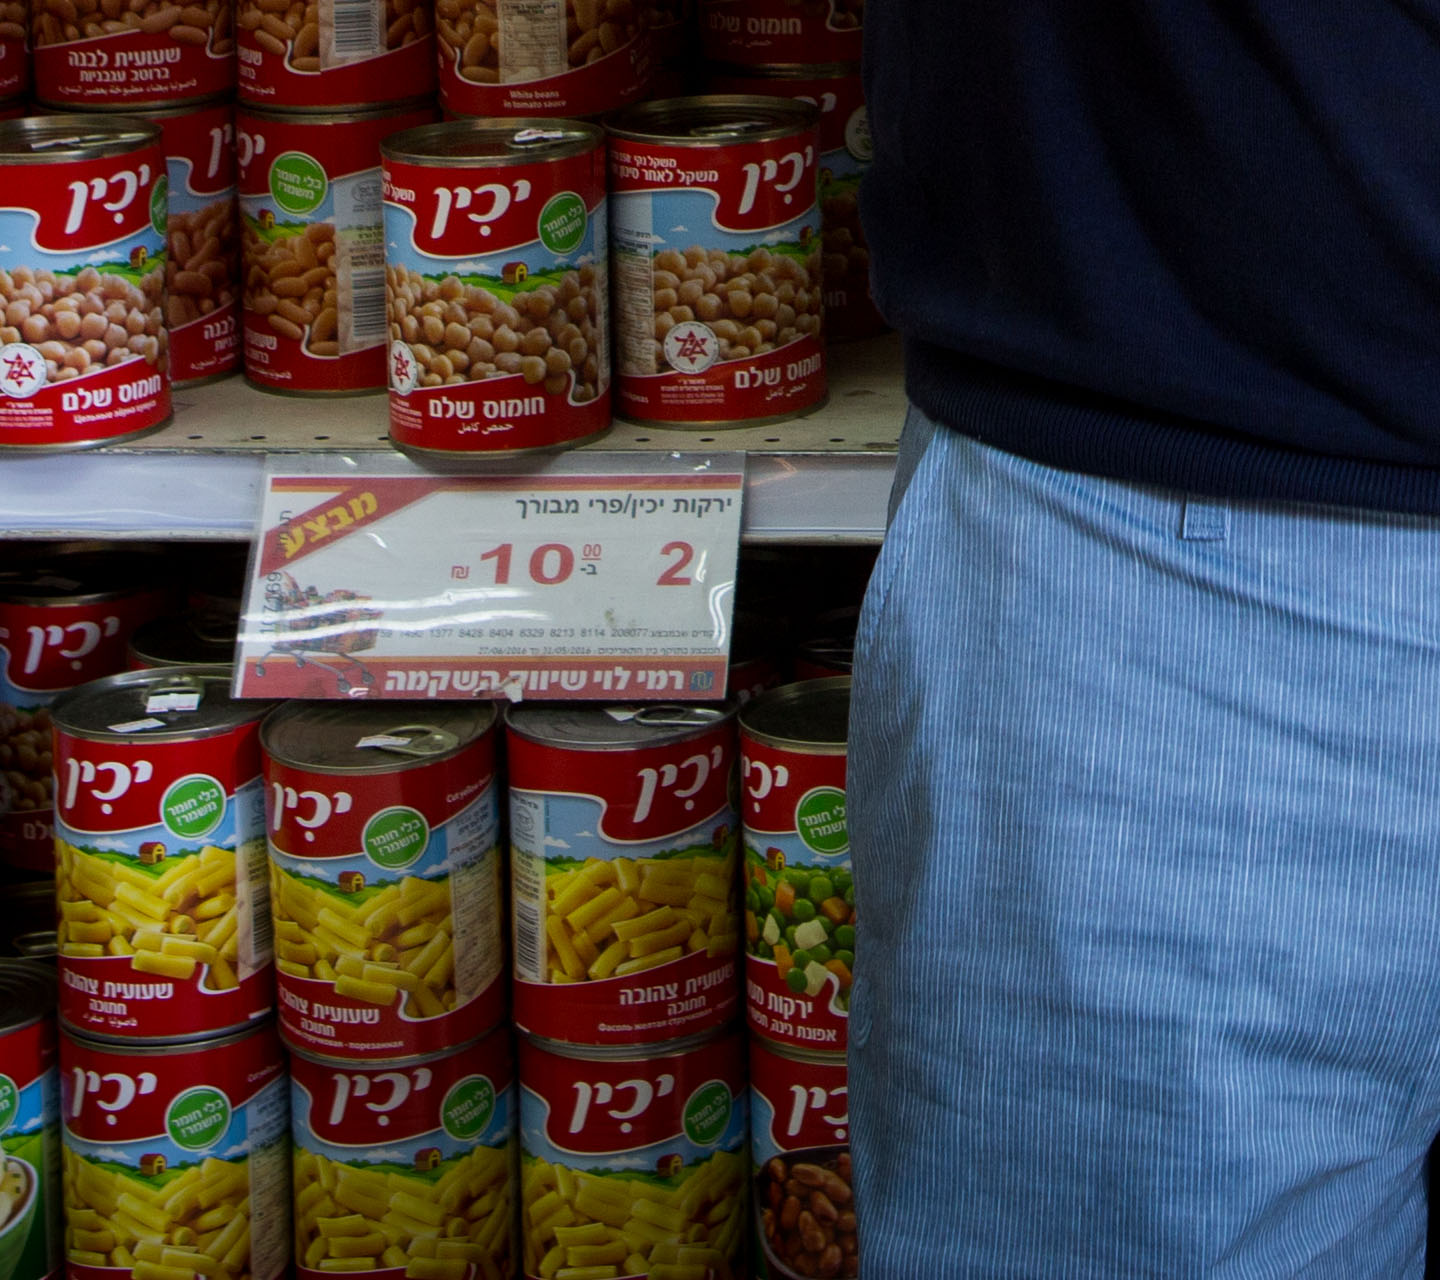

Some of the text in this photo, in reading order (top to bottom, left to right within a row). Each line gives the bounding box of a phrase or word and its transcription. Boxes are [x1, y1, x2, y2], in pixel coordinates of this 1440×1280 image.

[428, 395, 546, 420] חומוס שלם
[514, 493, 733, 519] ירקות יכין/פרי מבורך
[479, 543, 576, 584] 10
[656, 541, 695, 586] 2
